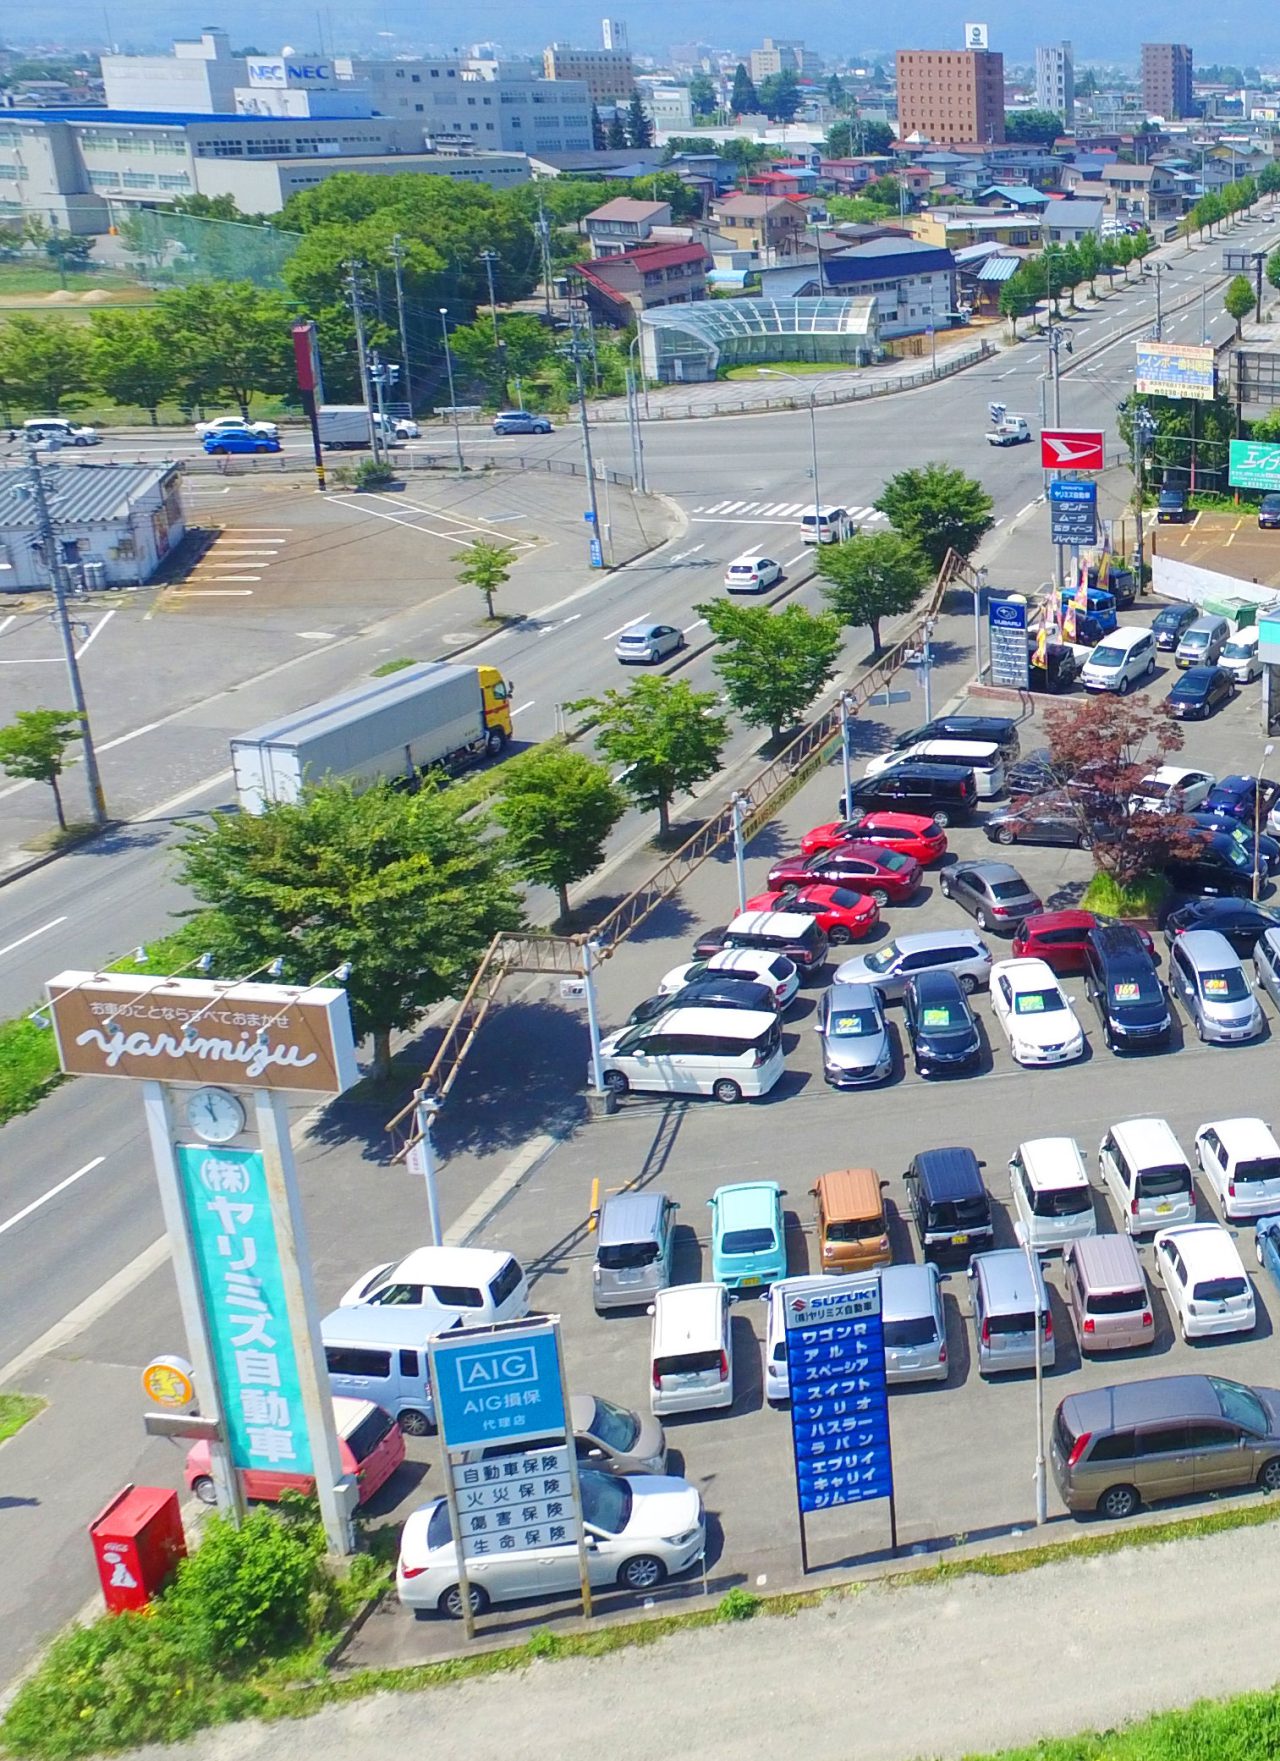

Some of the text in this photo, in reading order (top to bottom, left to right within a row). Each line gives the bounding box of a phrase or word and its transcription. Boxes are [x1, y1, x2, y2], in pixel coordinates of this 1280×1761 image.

[250, 65, 283, 80] NEC
[288, 65, 329, 79] NEC
[993, 618, 1022, 627] SUBARU
[90, 1001, 290, 1029] お車のことならすべておまかせ
[810, 1286, 877, 1309] SUZUKI
[802, 1323, 867, 1345] ワゴンR
[804, 1340, 867, 1363] アルト
[467, 1355, 527, 1384] AIG
[806, 1358, 868, 1380] スペーシア
[807, 1378, 870, 1400] スイフト
[463, 1388, 541, 1415] AIG損保
[809, 1397, 872, 1420] ソリオ
[483, 1414, 526, 1431] 代理店
[810, 1418, 873, 1438] ハスラー
[463, 1455, 559, 1484] 自動車保険
[812, 1452, 874, 1475] エブリイ
[814, 1467, 876, 1491] キャリイ
[466, 1478, 561, 1508] 火災保険
[814, 1487, 878, 1508] ジムニー
[470, 1501, 564, 1531] 傷害保険
[474, 1524, 567, 1555] 生命保険
